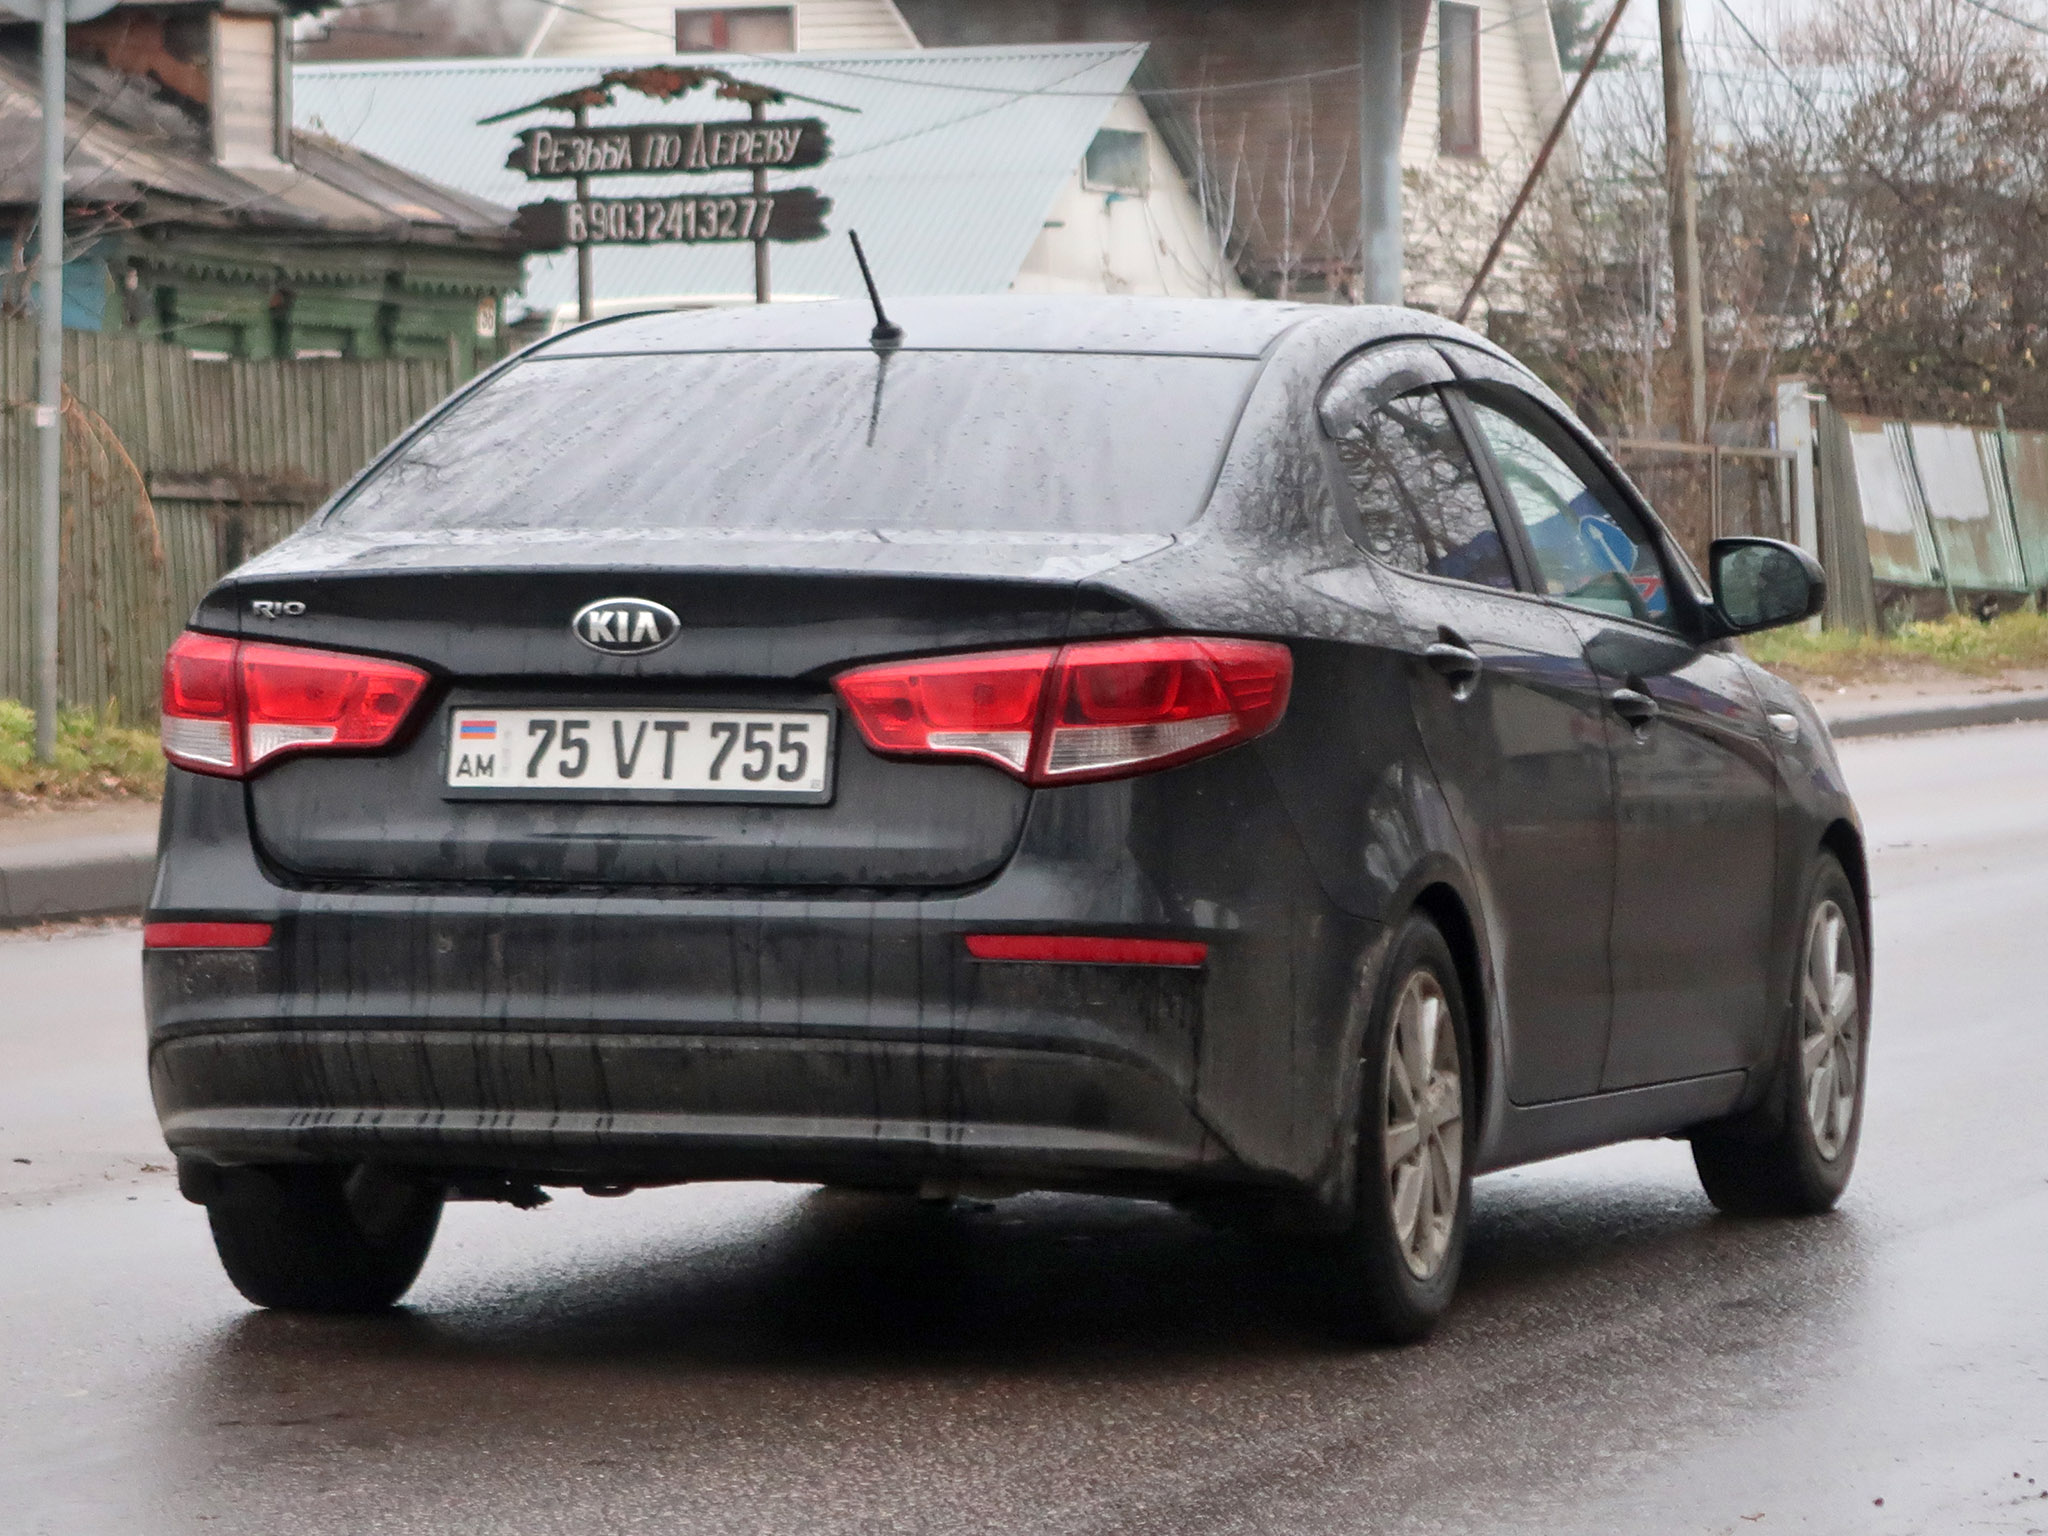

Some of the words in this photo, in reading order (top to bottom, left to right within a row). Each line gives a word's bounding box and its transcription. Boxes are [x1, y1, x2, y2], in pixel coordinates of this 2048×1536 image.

[645, 133, 682, 169] ПО
[253, 600, 307, 619] RIO
[588, 611, 662, 642] KIA
[456, 754, 494, 778] AM
[526, 719, 591, 778] 75
[612, 719, 690, 780] VT
[709, 721, 809, 782] 755
